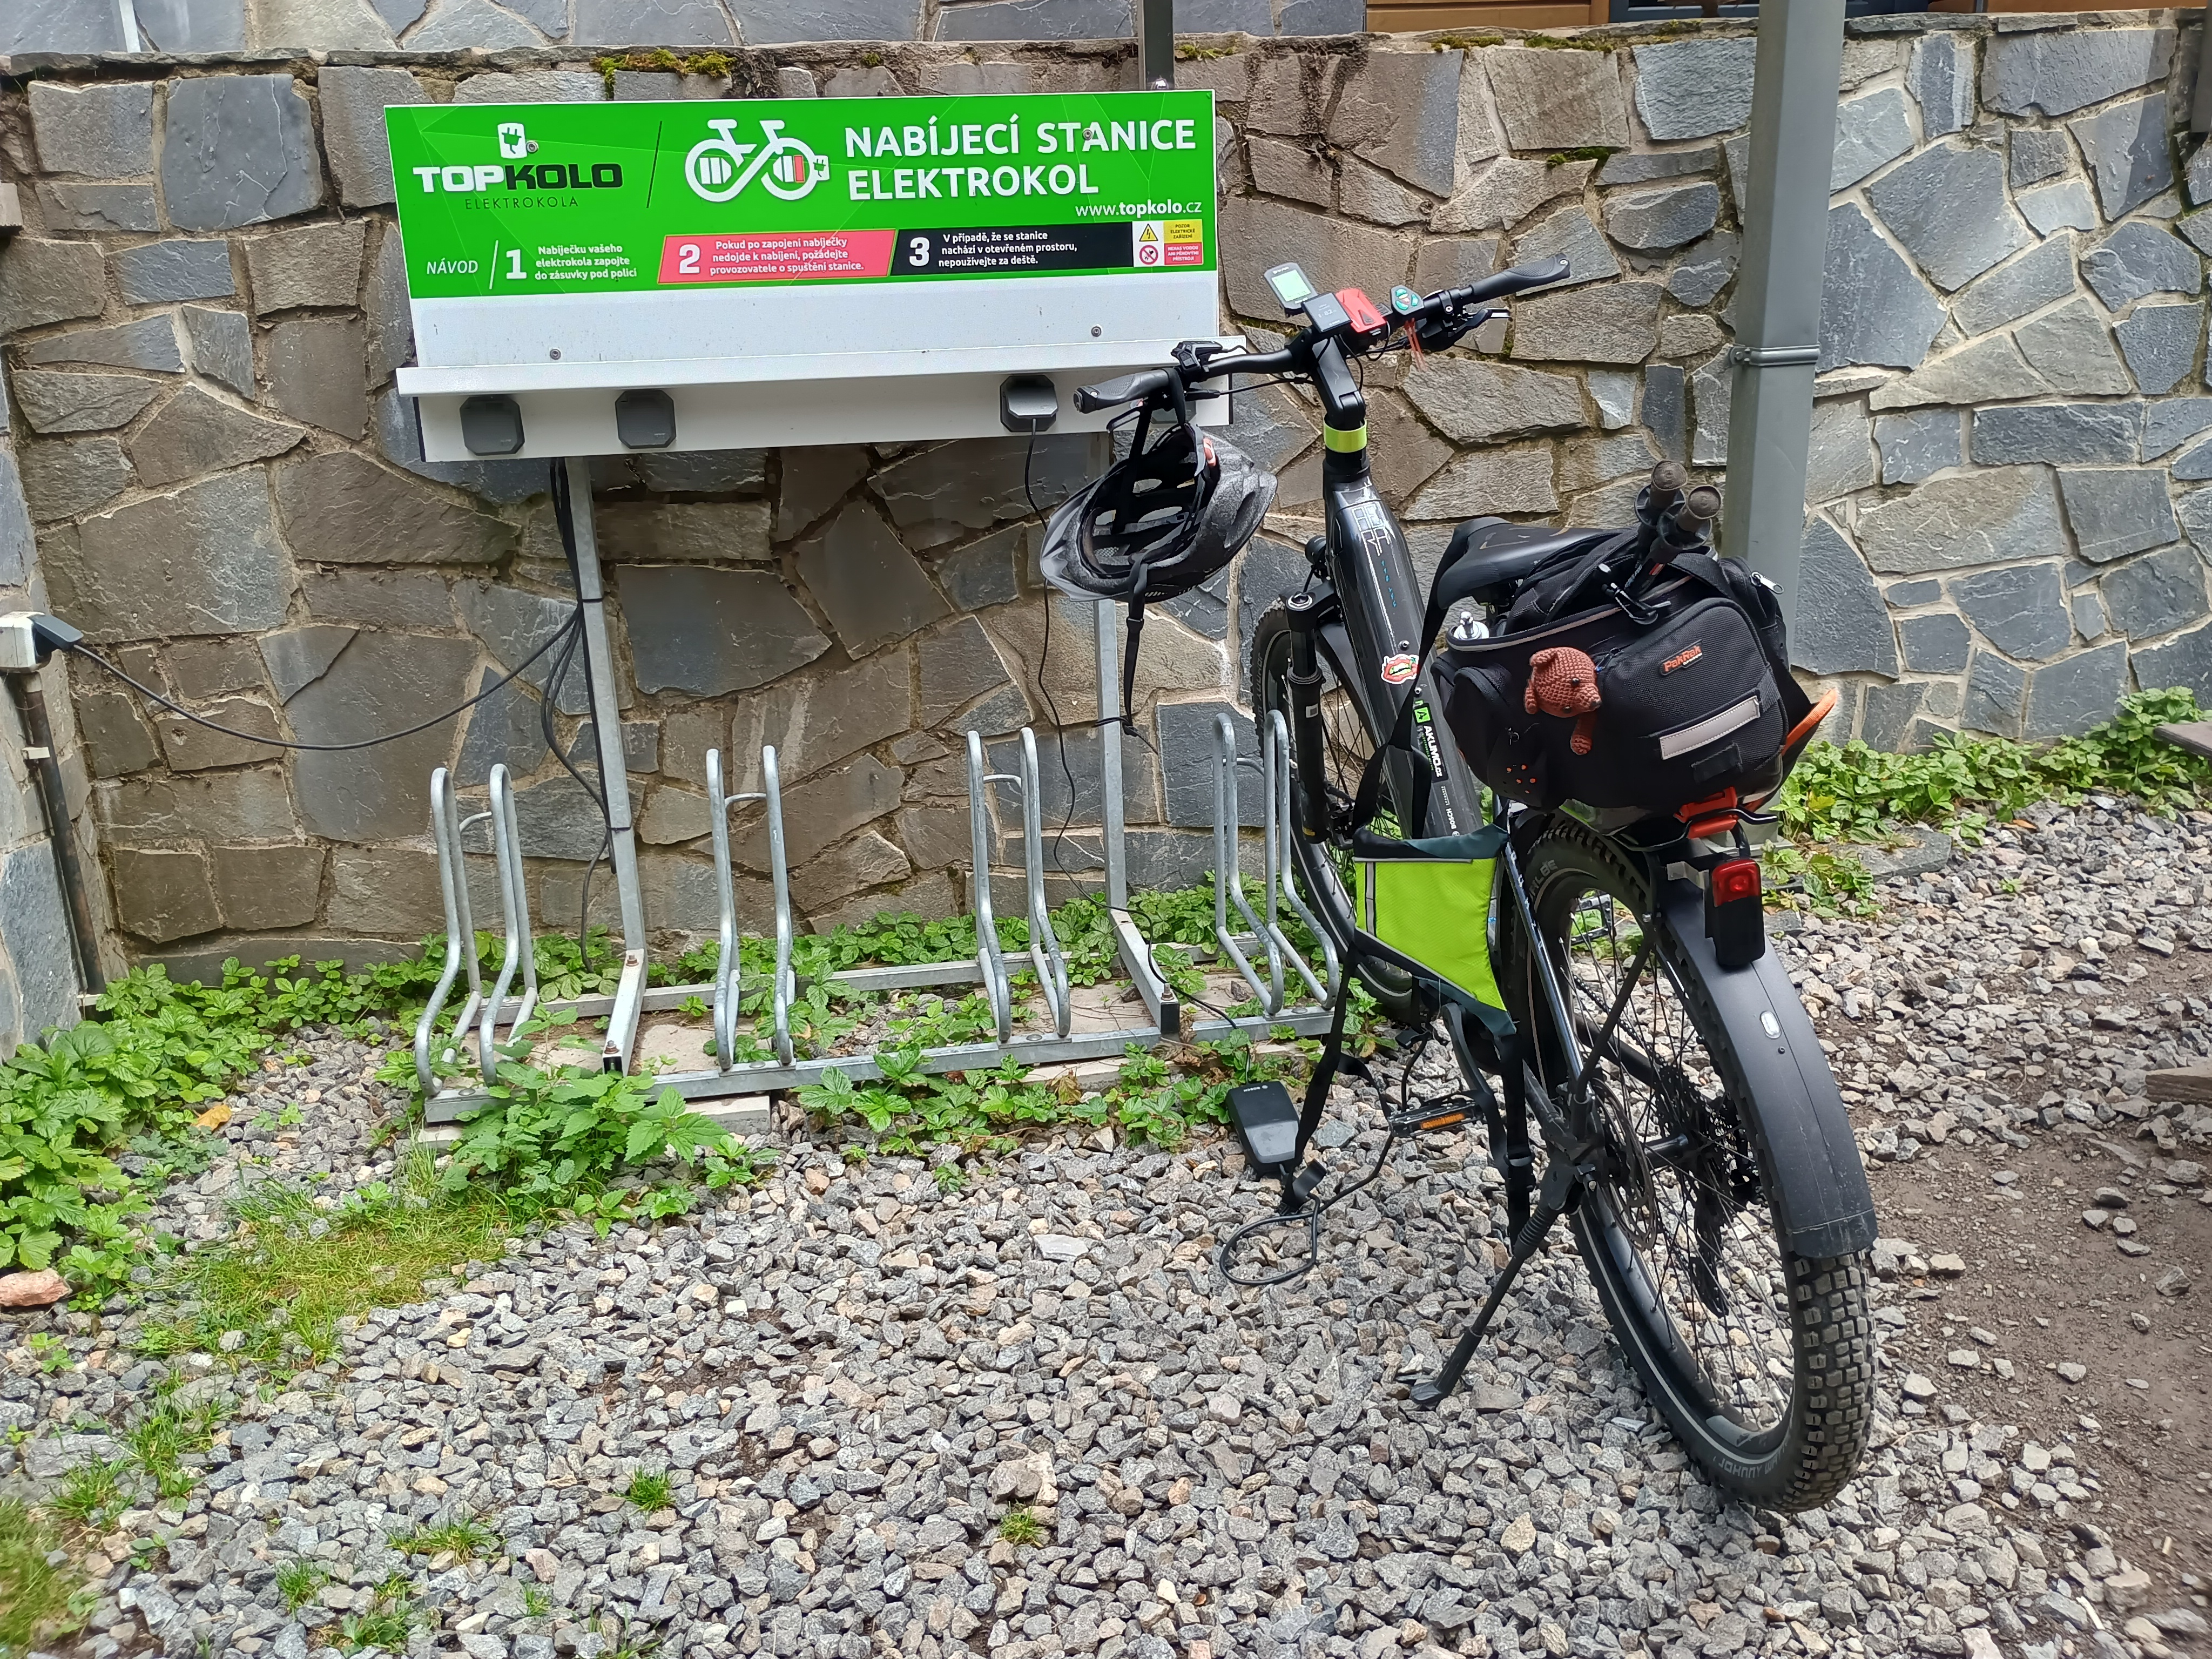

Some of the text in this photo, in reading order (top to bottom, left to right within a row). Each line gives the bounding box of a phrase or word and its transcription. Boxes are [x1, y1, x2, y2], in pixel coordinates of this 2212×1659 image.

[845, 113, 1196, 157] NABÍJECÍ STANICE
[413, 163, 623, 193] TOPKOLO
[848, 164, 1099, 200] ELEKTROKOL
[465, 196, 578, 210] ELEKTROKOLA
[1075, 199, 1202, 218] www.topkolo.cz
[716, 237, 847, 251] Pokud po zapojení nabíječky
[943, 234, 950, 242] V
[953, 232, 989, 244] případě,
[992, 232, 1001, 241] že
[1016, 231, 1048, 240] stanice
[538, 244, 623, 256] Nabíječku vašeho
[713, 249, 848, 263] nedojde k nabíjení, požádejte
[909, 237, 930, 266] 3
[942, 245, 975, 254] nachází
[985, 243, 1034, 253] otevřeném
[1036, 243, 1077, 253] prostoru,
[426, 257, 478, 275] NÁVOD
[505, 249, 527, 279] 1
[536, 256, 630, 267] elektrokola zapojte
[678, 244, 700, 274] 2
[939, 257, 996, 268] nepoužívejte
[1011, 255, 1038, 264] deště.
[535, 268, 637, 280] do zásuvky pod policí
[710, 263, 777, 276] provozovatele
[787, 261, 826, 273] spuštění
[828, 261, 864, 270] stanice.
[1663, 645, 1701, 672] PakRak
[1423, 725, 1443, 778] AKUMO.cz
[1446, 808, 1457, 830] BOSCH
[1718, 1458, 1763, 1479] JOHNNY
